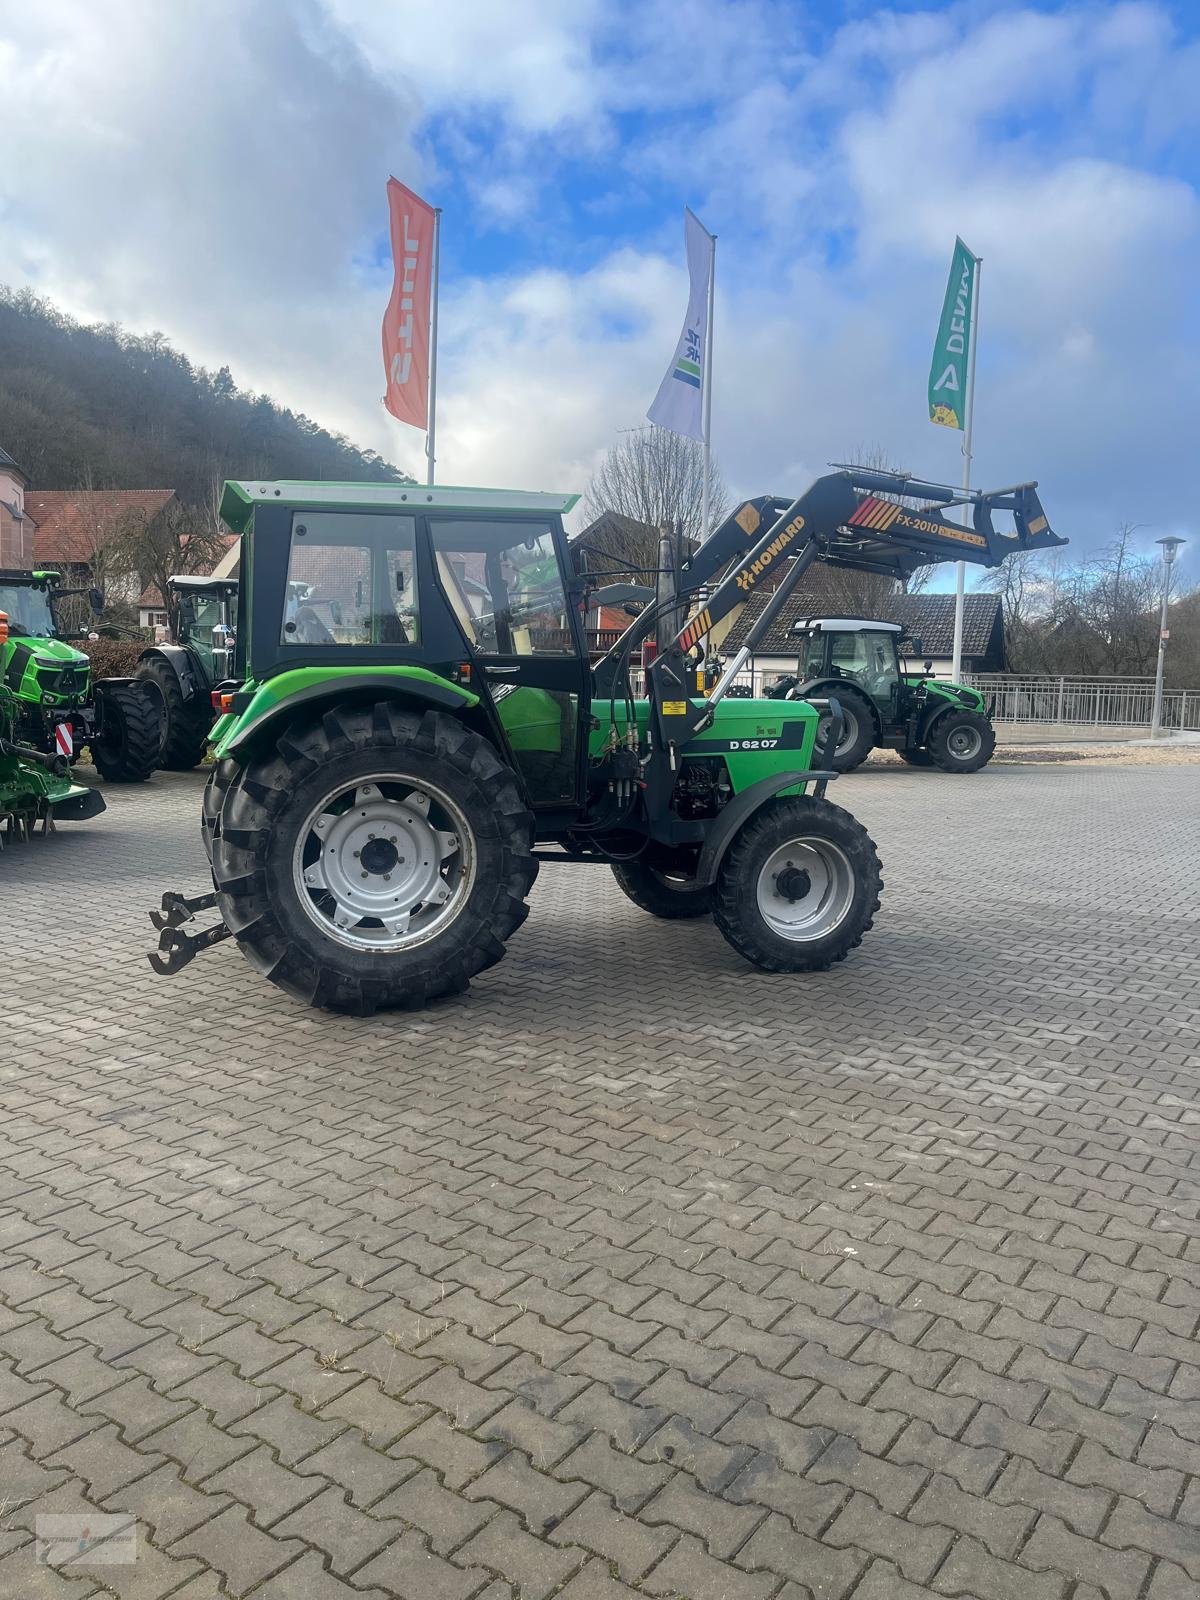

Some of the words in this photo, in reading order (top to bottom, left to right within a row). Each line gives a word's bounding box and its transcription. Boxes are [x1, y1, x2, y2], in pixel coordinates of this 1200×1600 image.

[895, 514, 939, 534] FX-2010
[750, 515, 805, 576] HOWARD
[729, 741, 740, 750] D
